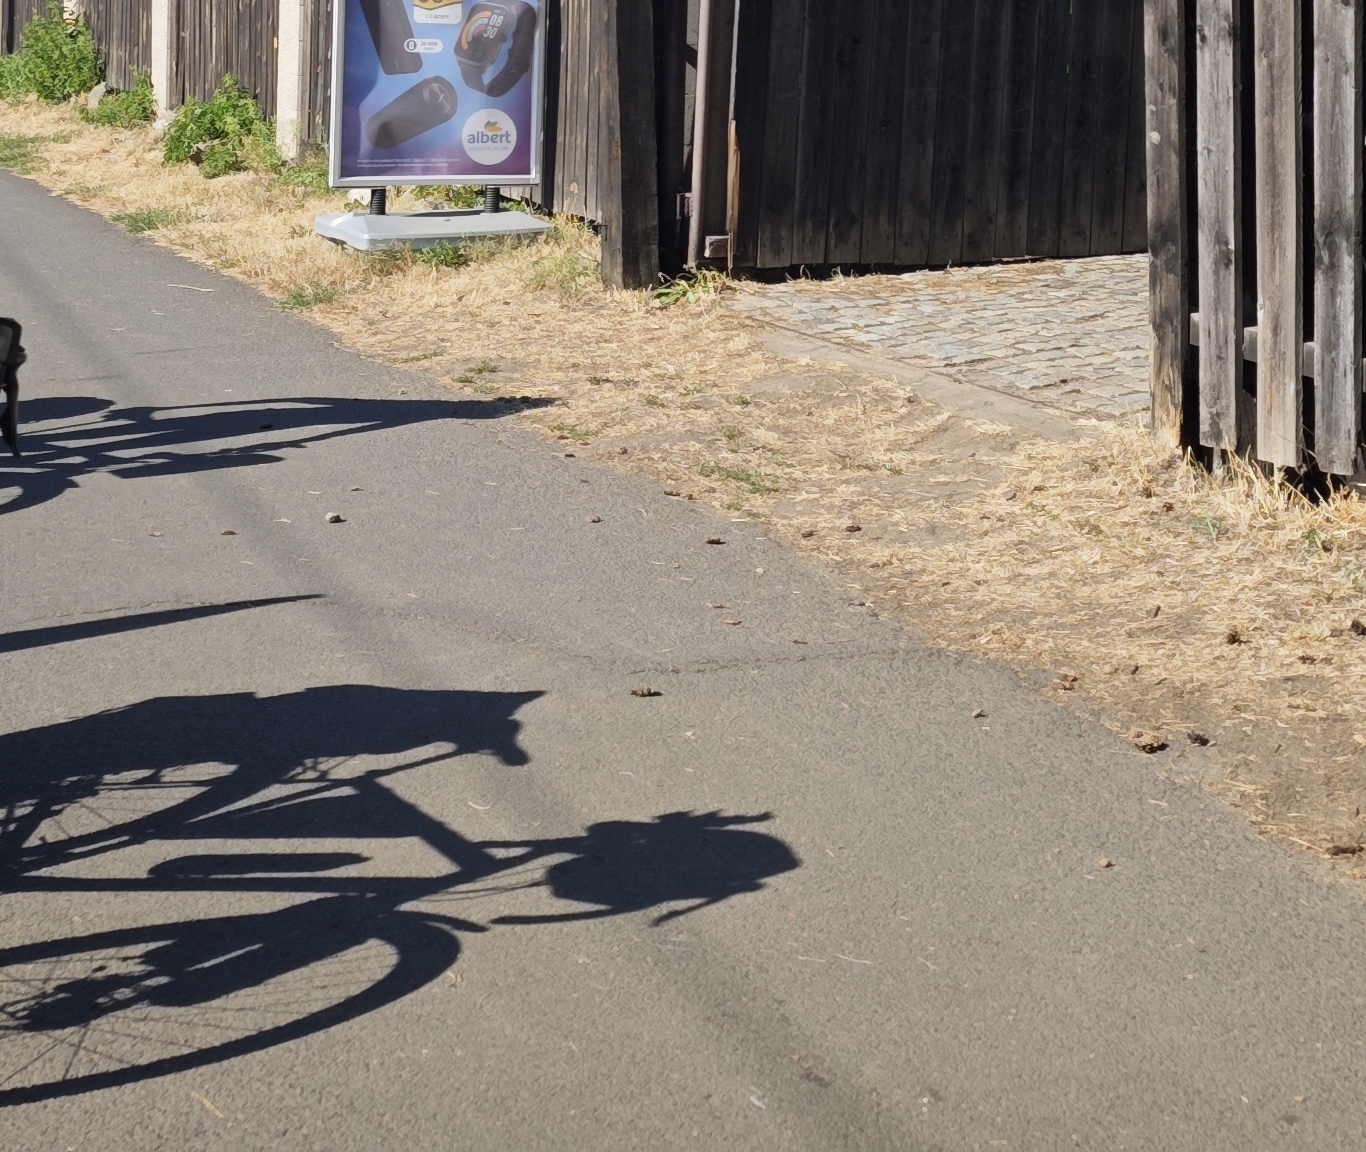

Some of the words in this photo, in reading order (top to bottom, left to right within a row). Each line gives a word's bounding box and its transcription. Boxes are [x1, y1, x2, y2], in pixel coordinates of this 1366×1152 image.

[489, 14, 504, 26] 08
[483, 26, 498, 38] 30
[467, 131, 511, 144] albert
